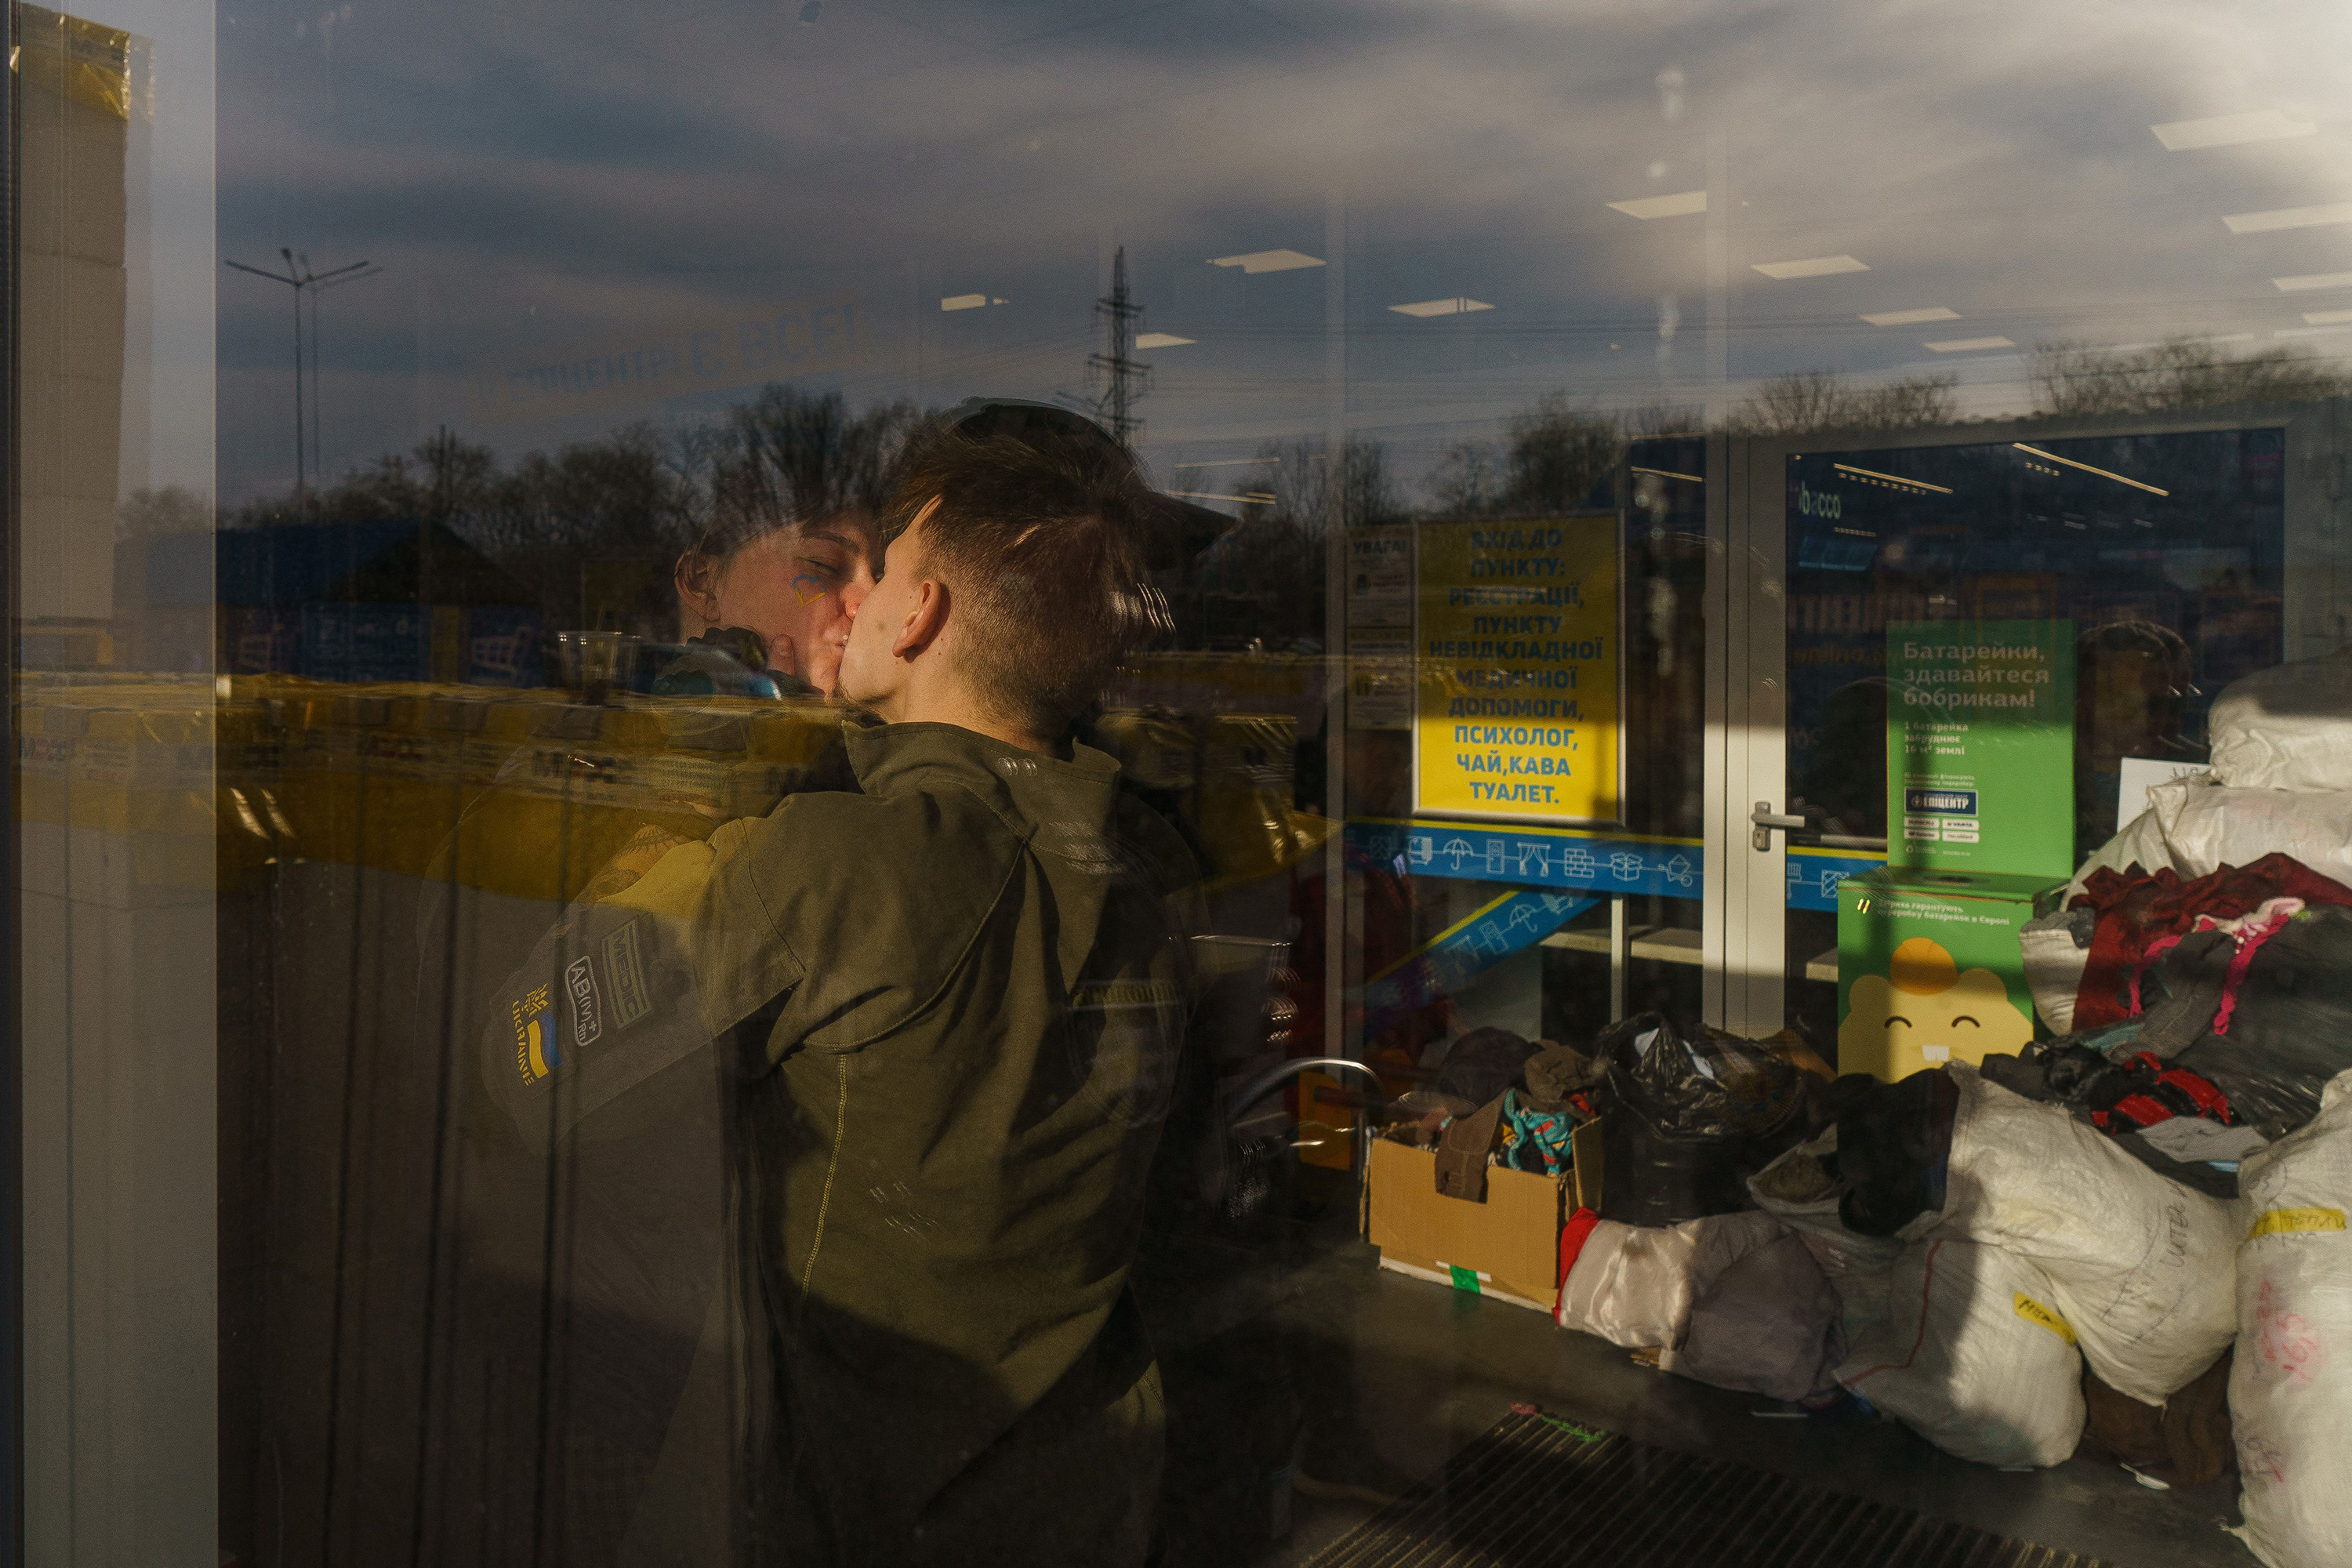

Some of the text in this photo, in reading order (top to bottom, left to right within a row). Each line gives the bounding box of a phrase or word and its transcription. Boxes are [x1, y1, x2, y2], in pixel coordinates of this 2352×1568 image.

[1471, 529, 1562, 551] ВХІД ДО
[1470, 559, 1566, 578] ПУНКТУ:
[1474, 616, 1562, 634] ПУНКТУ
[1430, 637, 1603, 662] НЕВІДКЛАДНОЇ
[1904, 642, 2045, 663] Батарейки,
[1456, 668, 1577, 690] МЕДИЧНОЇ
[1904, 666, 2050, 684] здавайтеся
[1449, 697, 1584, 721] ДОПОМОГИ,
[1904, 688, 2035, 711] бобрикам!
[1455, 725, 1579, 750] ПСИХОЛОГ,
[1913, 721, 1969, 733] батарейка
[1904, 733, 1961, 745] забруднює
[1936, 746, 1965, 755] землі
[1457, 751, 1571, 777] ЧАЙ,КАВА
[1470, 782, 1560, 804] ТУАЛЕТ.
[1923, 796, 1969, 809] ЕПІЦЕНТР
[612, 934, 640, 1018] MEDIC
[513, 1000, 535, 1087] UKRAINE
